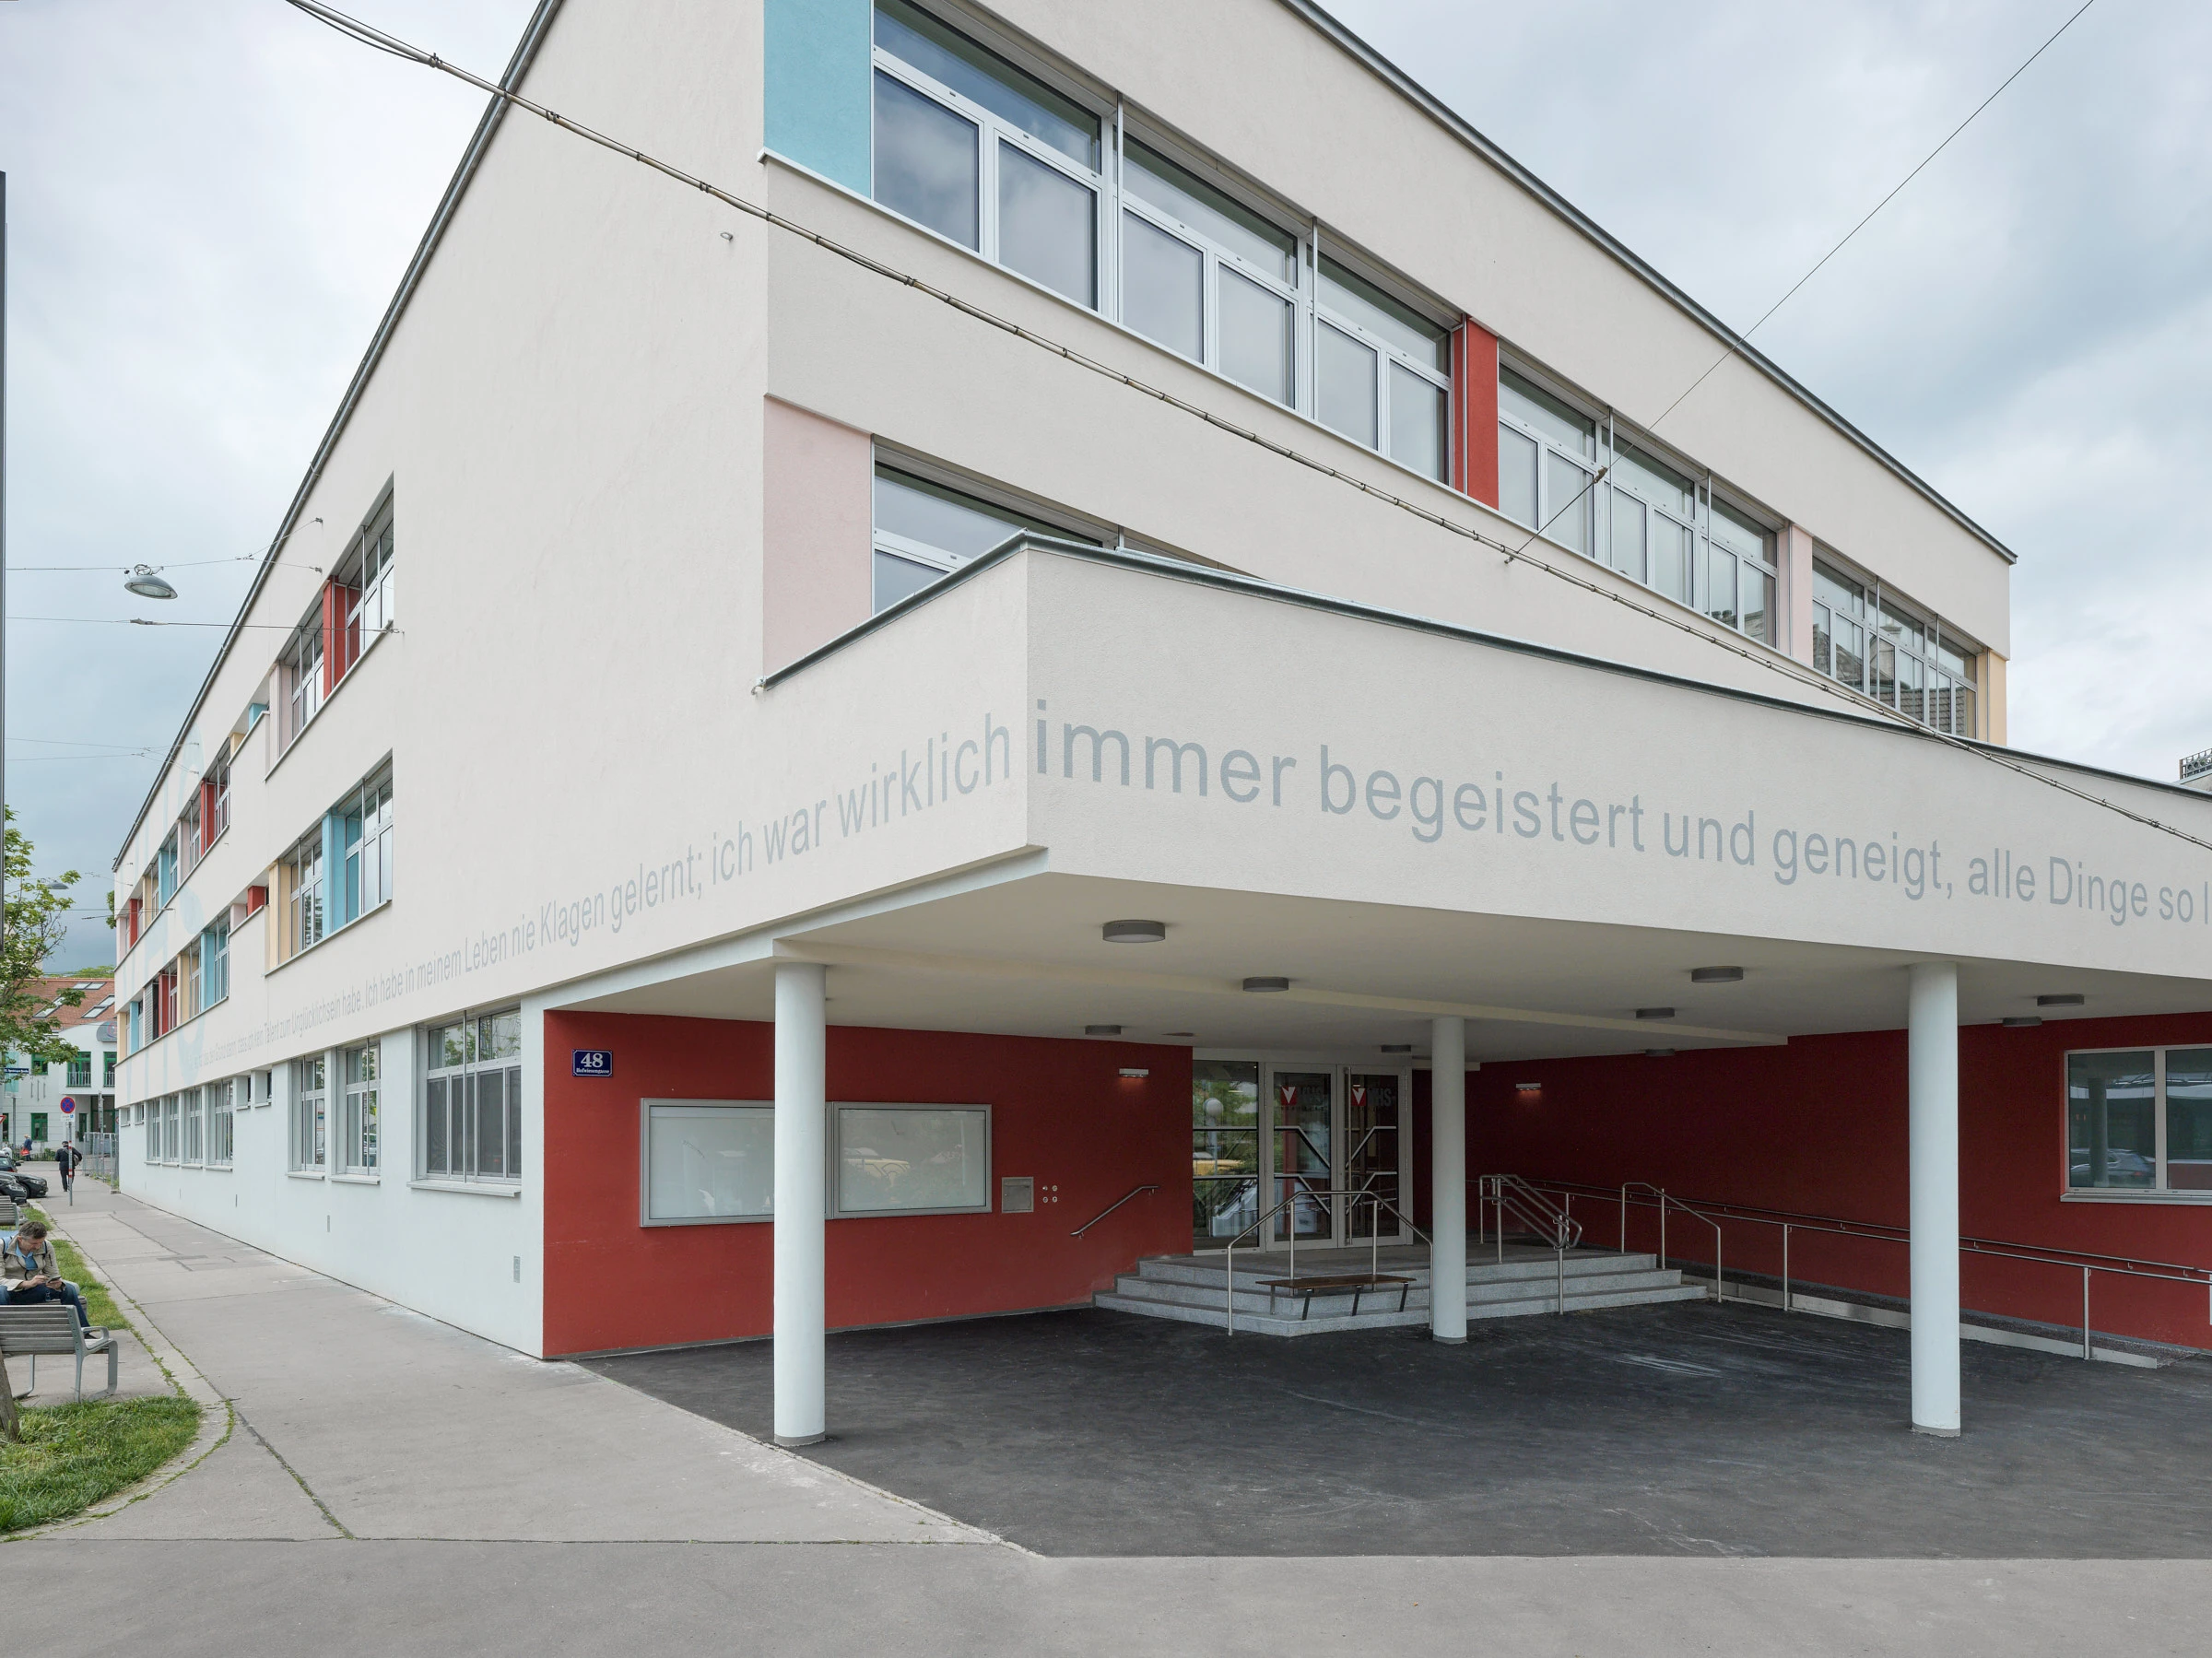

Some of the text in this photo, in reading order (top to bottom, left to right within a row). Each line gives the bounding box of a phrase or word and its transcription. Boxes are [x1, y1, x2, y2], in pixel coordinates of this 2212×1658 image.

[264, 1018, 279, 1044] Talent
[279, 1017, 291, 1040] zum
[291, 993, 341, 1038] Unglücklichsein
[342, 986, 365, 1017] habe.
[365, 977, 378, 1009] Ich
[380, 968, 404, 1004] habe
[405, 962, 415, 994] in
[417, 951, 462, 991] meinem
[465, 931, 507, 972] Leben
[512, 914, 535, 957] nie
[540, 891, 605, 947] Klagen
[611, 843, 702, 934] gelernt;
[712, 820, 753, 885] ich
[763, 799, 827, 864] war
[837, 712, 1010, 838] wirklich
[1035, 699, 1298, 807] immer
[1319, 744, 1645, 853] begeistert
[1663, 810, 1755, 866] und
[1772, 828, 1953, 900] geneigt,
[1968, 848, 2036, 901] alle
[2049, 856, 2147, 926] Dinge
[2159, 886, 2194, 923] so
[581, 1052, 603, 1068] 48
